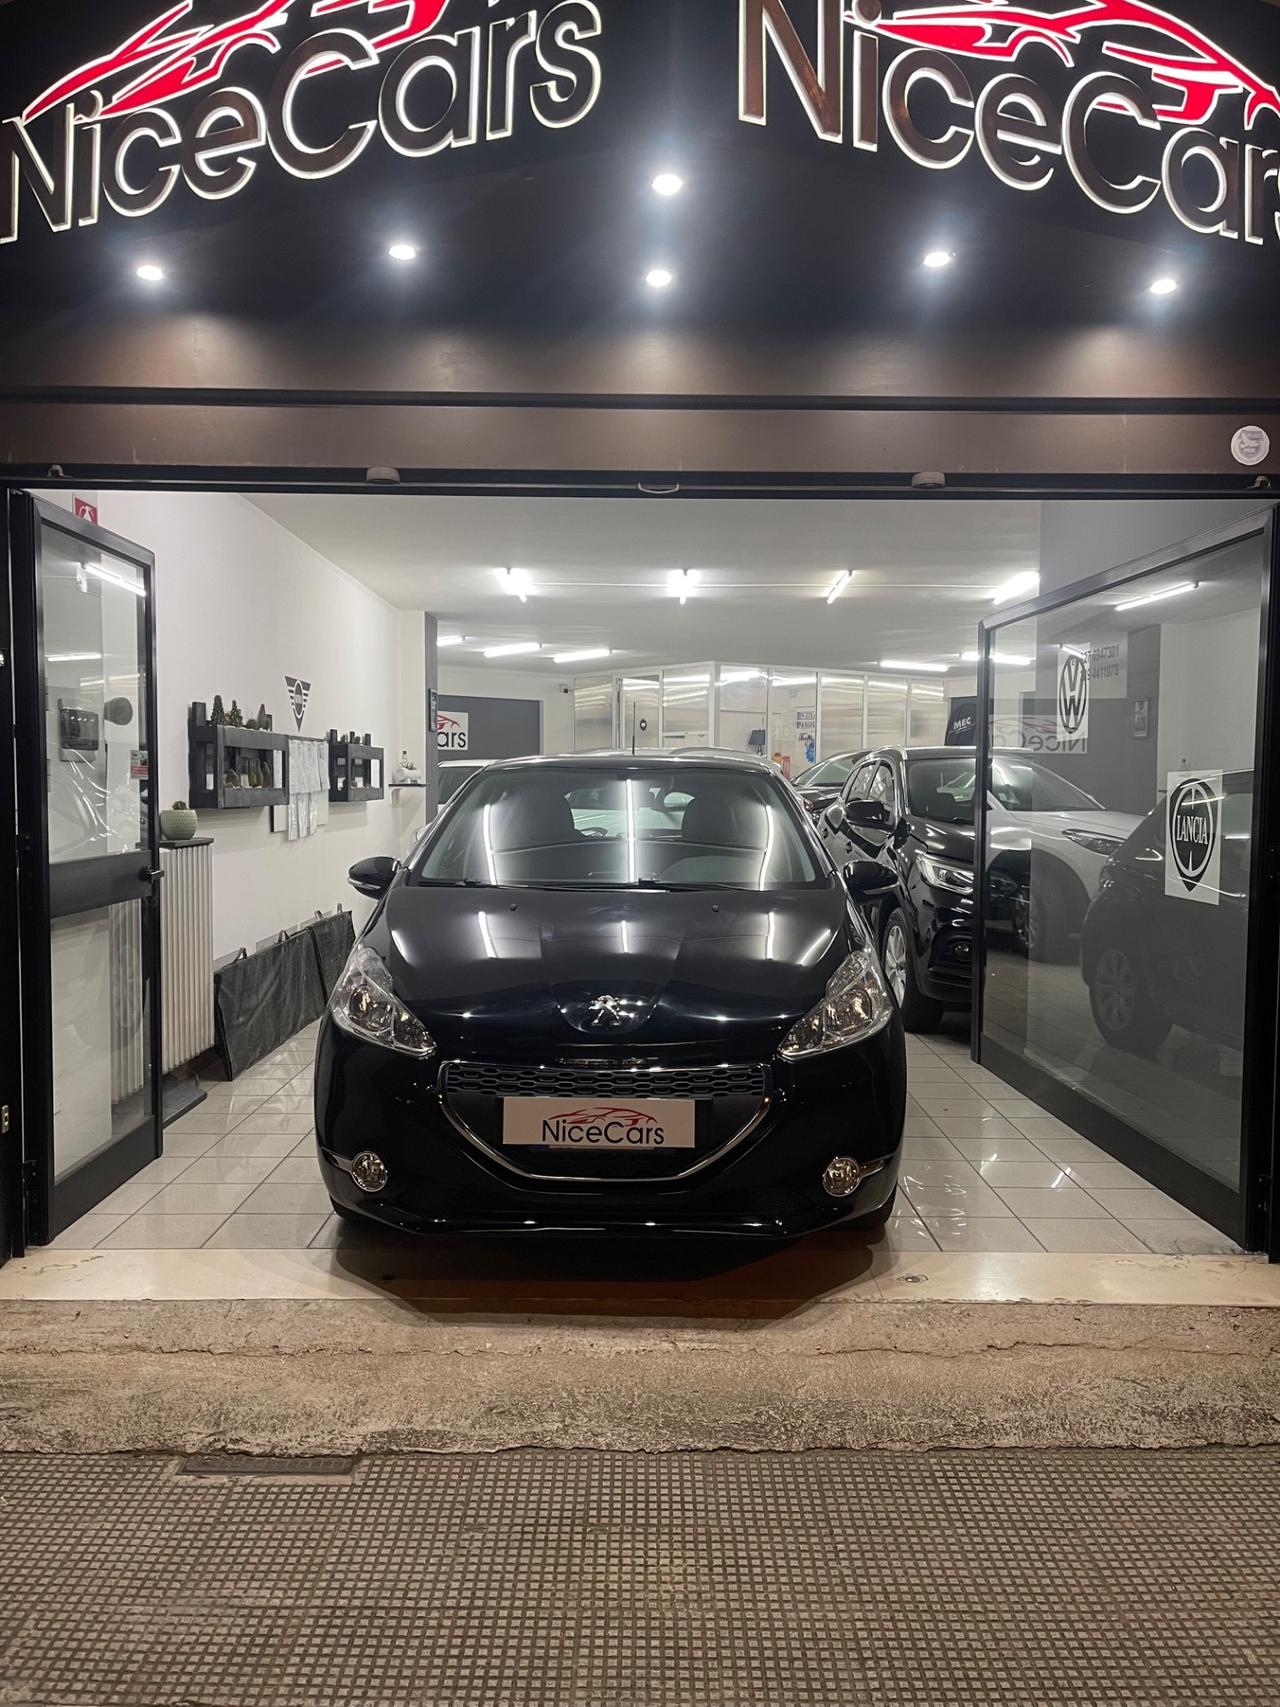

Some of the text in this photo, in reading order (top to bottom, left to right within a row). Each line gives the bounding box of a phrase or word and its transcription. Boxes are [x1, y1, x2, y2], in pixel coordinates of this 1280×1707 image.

[0, 0, 602, 244] NiceCars
[738, 0, 1280, 246] NiceCar
[953, 716, 972, 730] MEC
[1176, 815, 1209, 845] LANCIA
[542, 1119, 665, 1145] NiceCars
